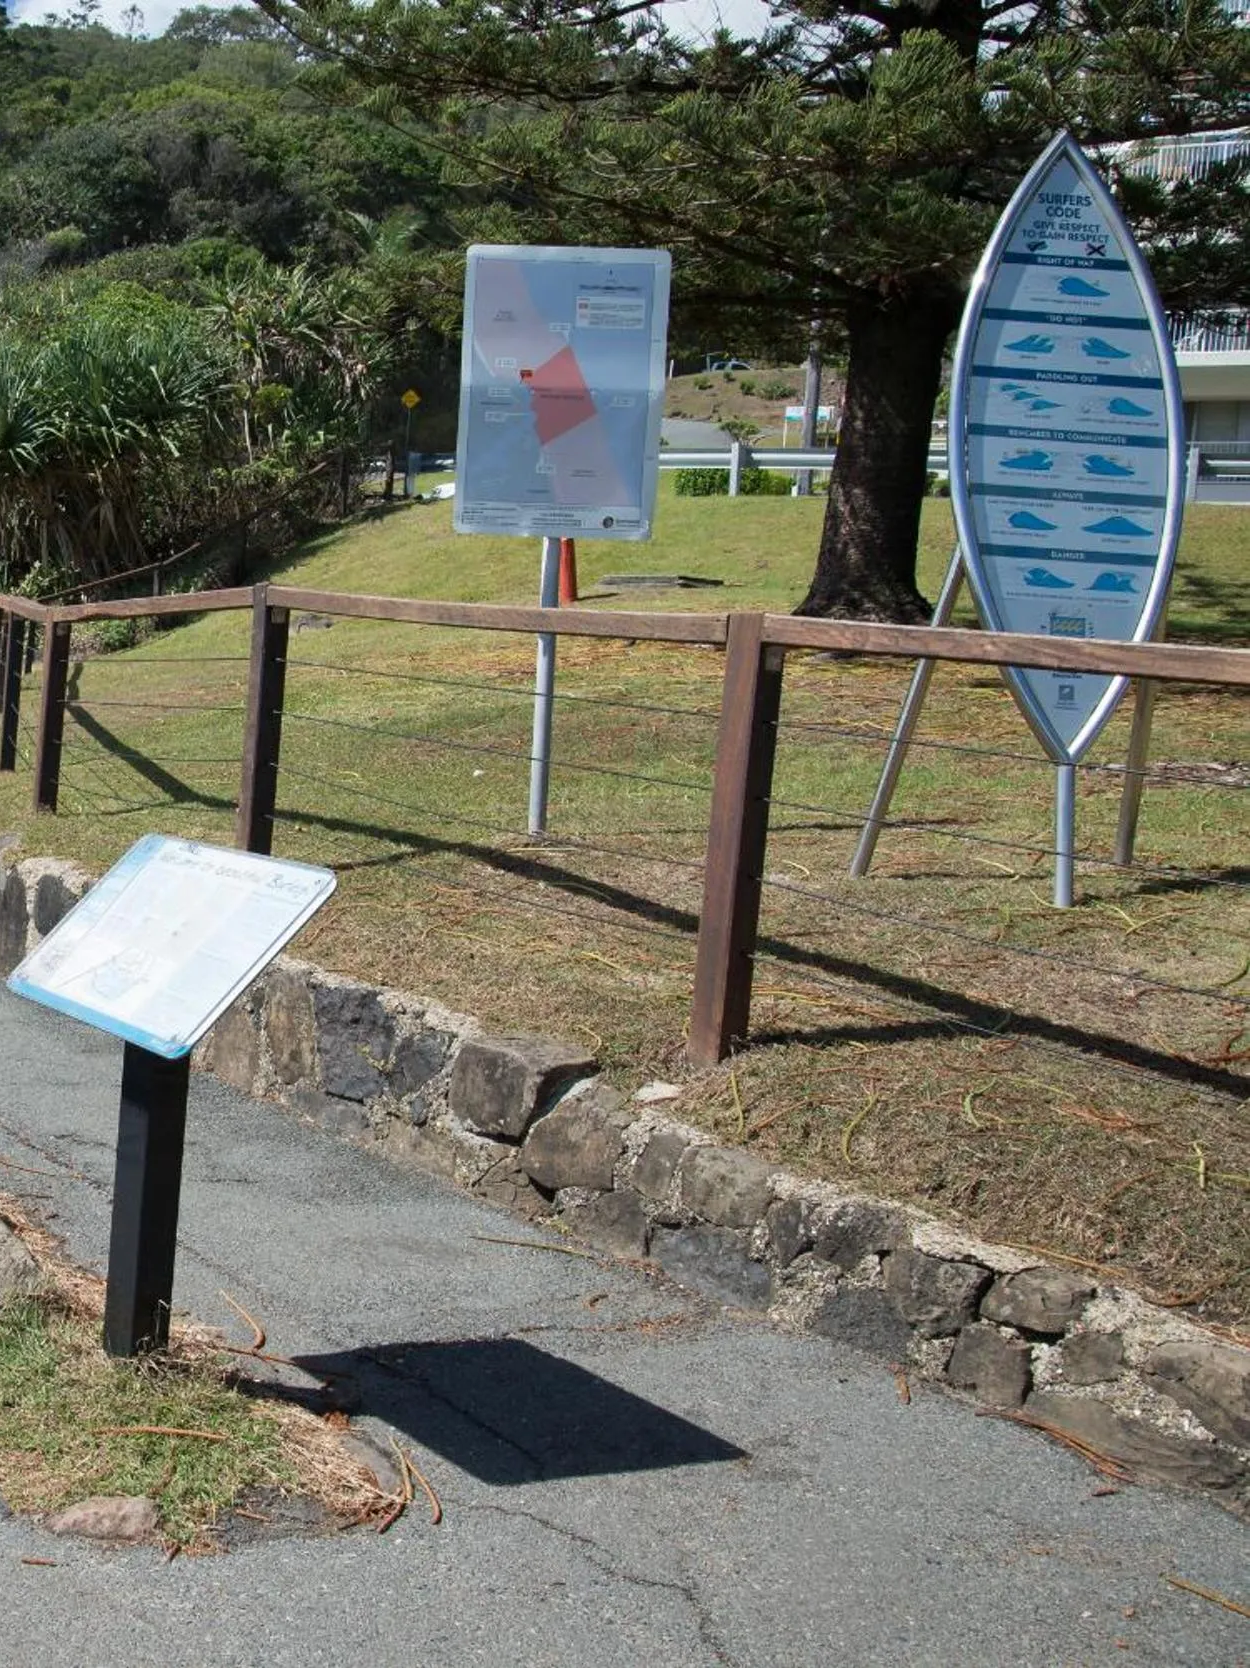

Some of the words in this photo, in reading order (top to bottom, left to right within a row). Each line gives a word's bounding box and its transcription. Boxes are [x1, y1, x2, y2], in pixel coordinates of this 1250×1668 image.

[1039, 193, 1091, 207] SURFERS
[1046, 207, 1081, 219] CODE
[1033, 220, 1055, 230] GIVE
[1059, 222, 1101, 233] RESPECT
[1022, 229, 1036, 238] TO
[1039, 230, 1065, 240] GAIN
[1068, 233, 1109, 243] RESPECT
[1037, 256, 1061, 265] RIGHT
[1036, 372, 1077, 383] PADDLING
[1081, 374, 1098, 383] OUT
[1009, 429, 1051, 440] REMEMBER
[1054, 431, 1065, 440] TO
[1067, 432, 1127, 445] COMMUNICATE
